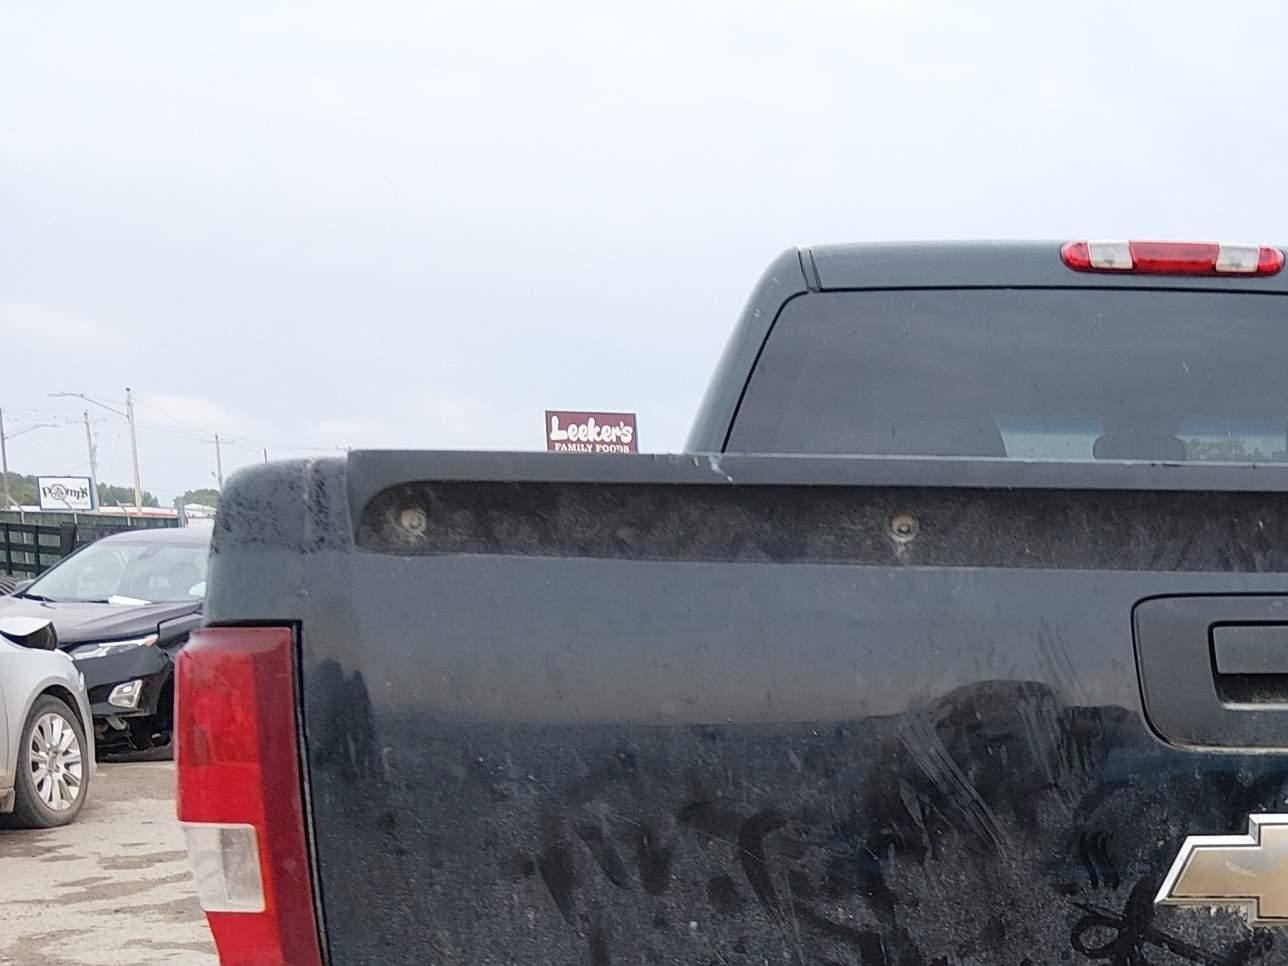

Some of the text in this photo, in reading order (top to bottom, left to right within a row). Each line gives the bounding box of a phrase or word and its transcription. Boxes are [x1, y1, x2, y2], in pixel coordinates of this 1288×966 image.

[550, 416, 633, 443] Leeker's
[554, 442, 630, 454] FAMILY FOODS
